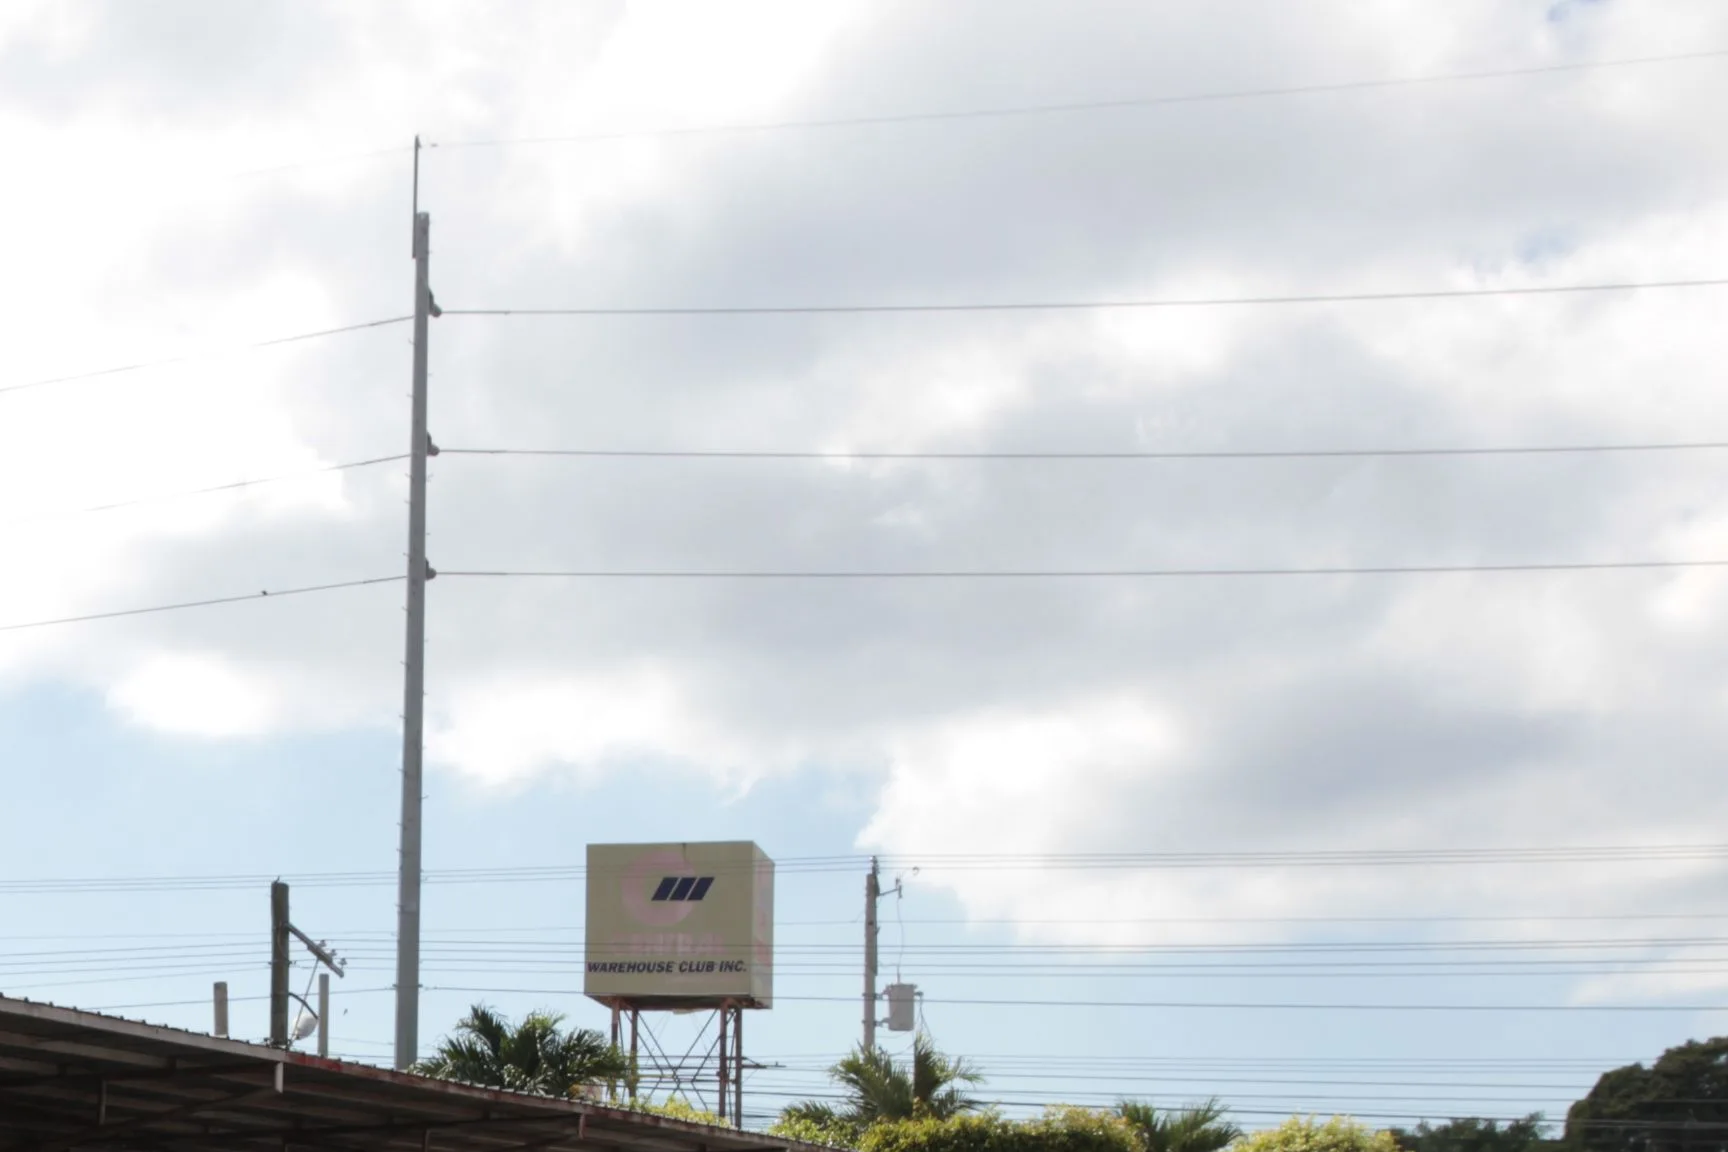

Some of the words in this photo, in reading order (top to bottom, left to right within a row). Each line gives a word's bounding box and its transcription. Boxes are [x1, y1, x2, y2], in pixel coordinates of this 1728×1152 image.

[587, 961, 673, 974] WAREHOUSE
[679, 960, 715, 973] CLUB
[719, 959, 747, 973] INC.
